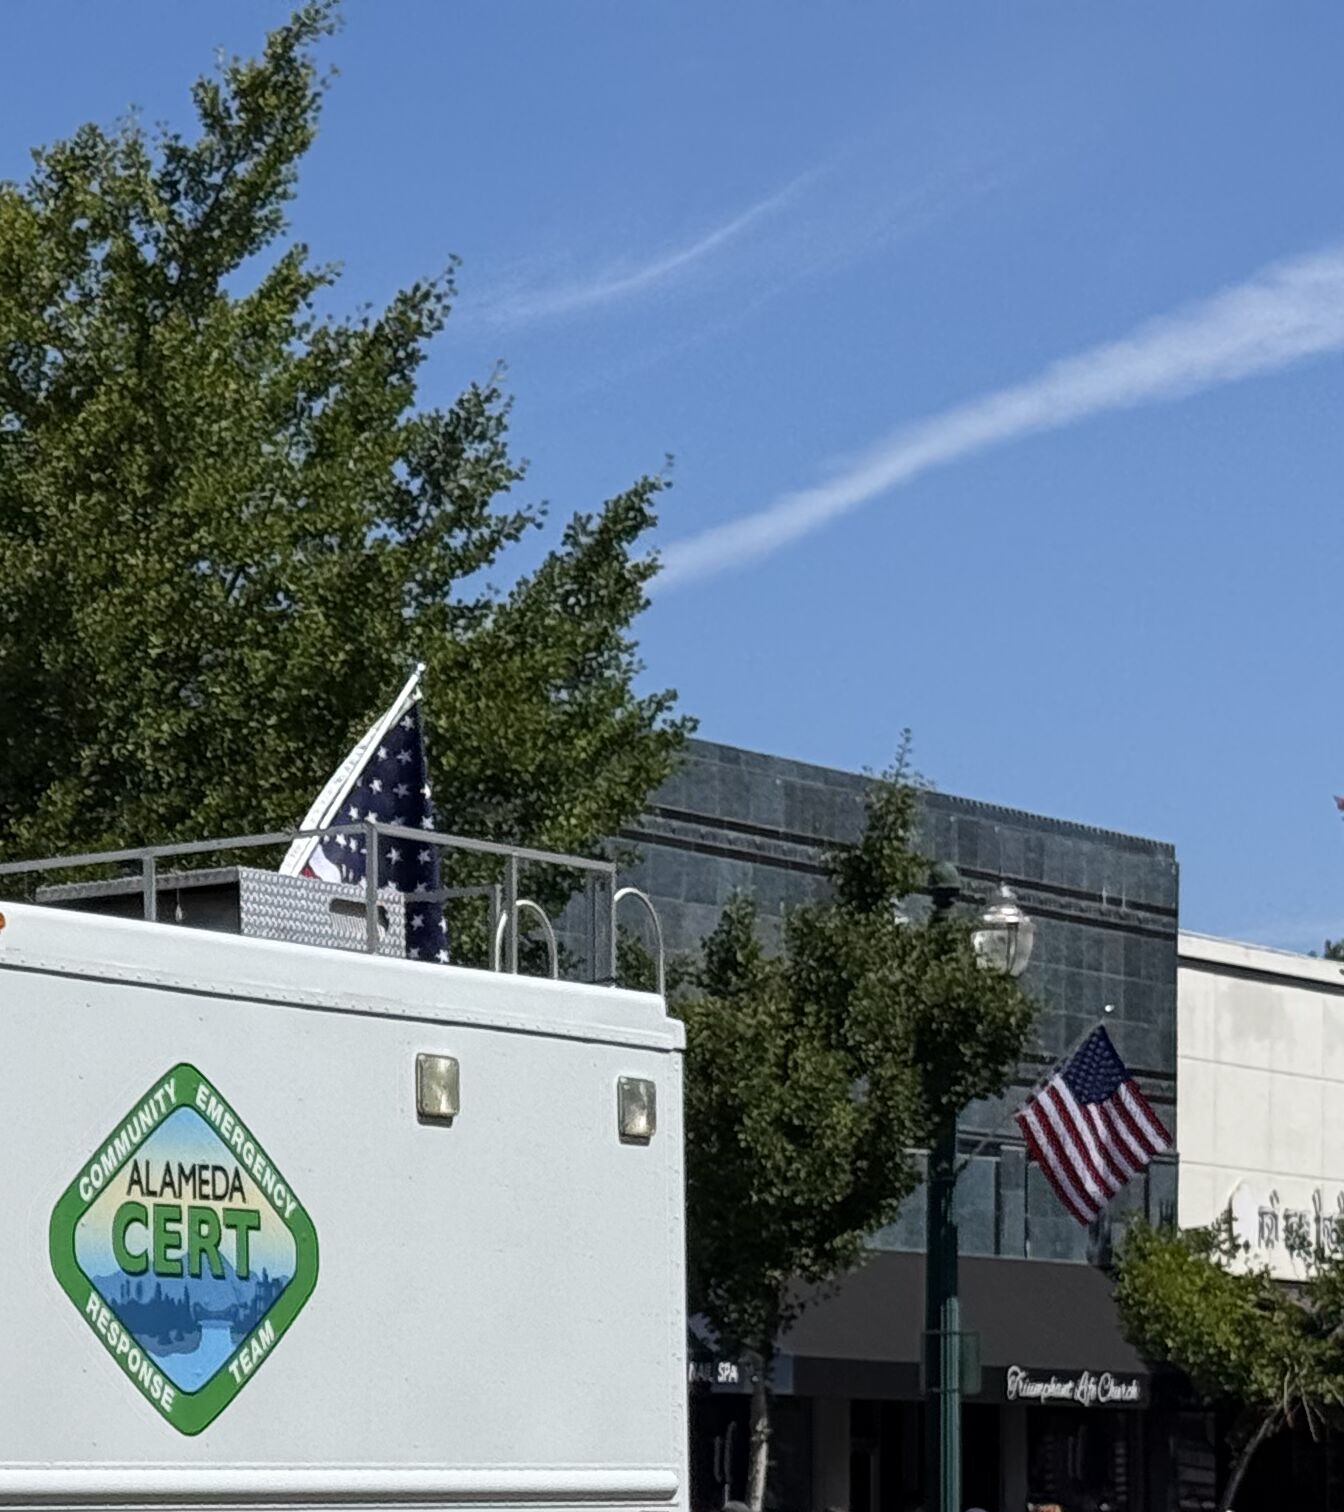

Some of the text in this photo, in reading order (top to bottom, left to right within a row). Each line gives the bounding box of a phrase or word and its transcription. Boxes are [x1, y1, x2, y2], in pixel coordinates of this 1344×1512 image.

[78, 1078, 179, 1203] COMMUNITY
[195, 1084, 298, 1219] EMERGENCY
[126, 1158, 247, 1205] ALAMEDA
[111, 1200, 262, 1281] CERT
[85, 1290, 177, 1413] RESPONSE
[228, 1319, 276, 1385] TEAM
[1098, 1372, 1140, 1403] Church
